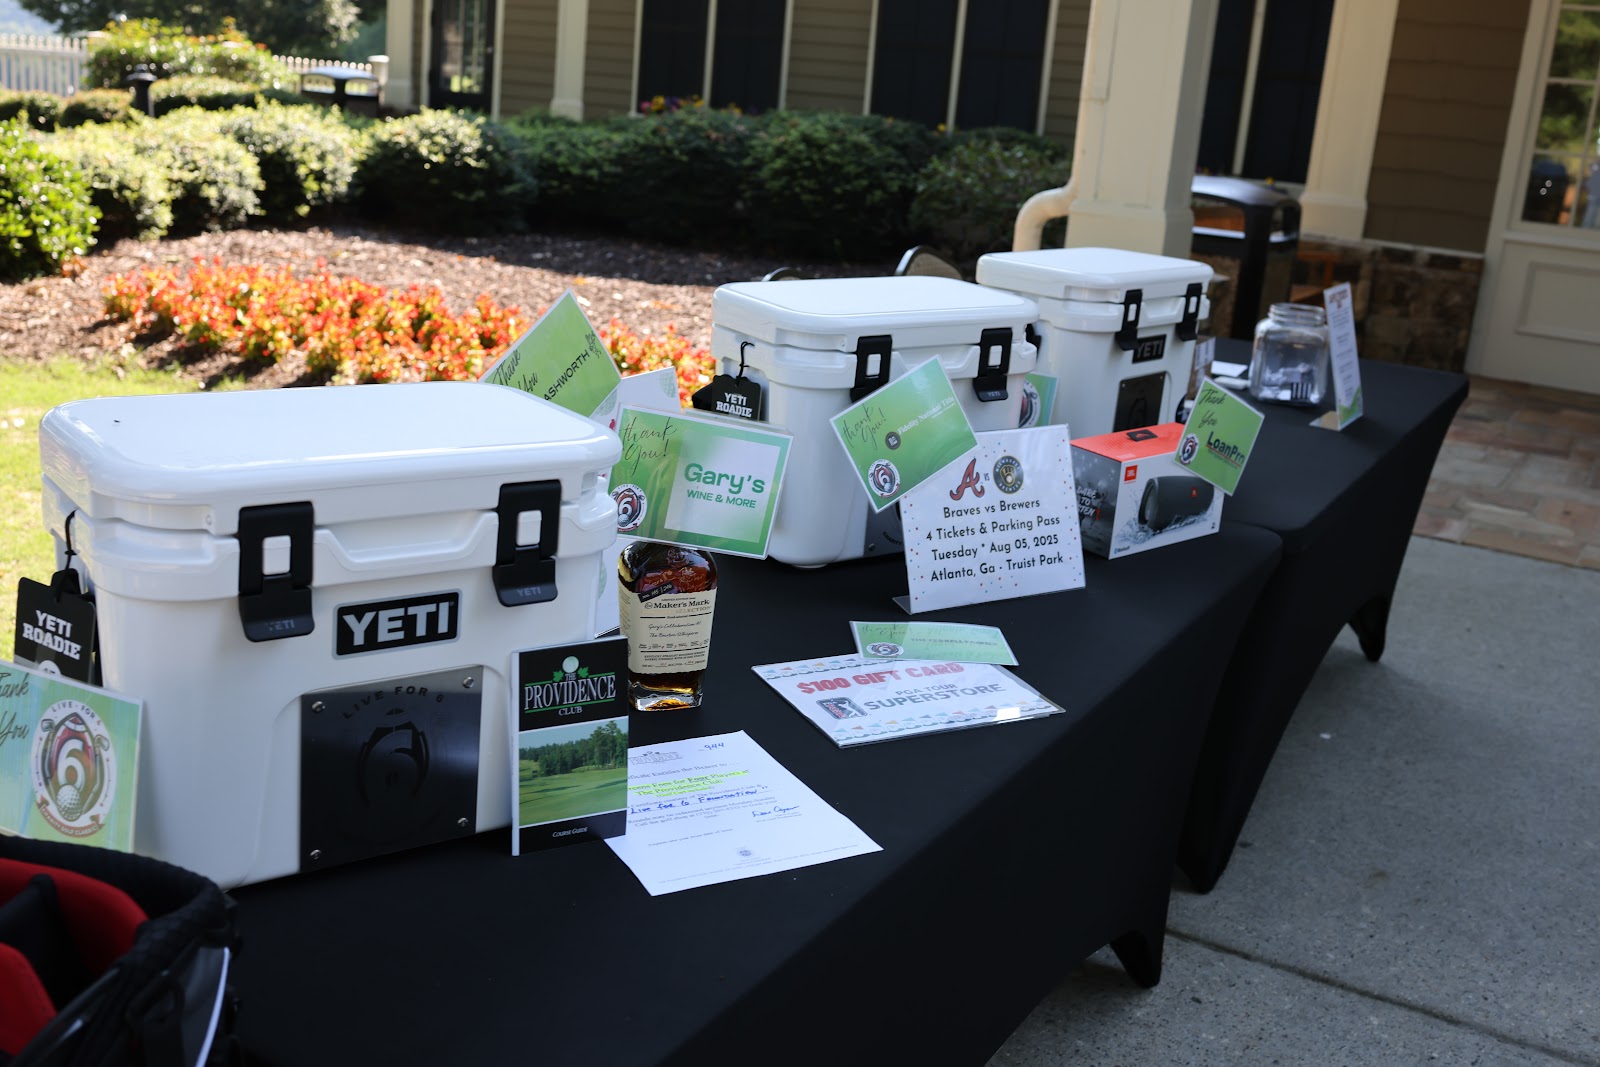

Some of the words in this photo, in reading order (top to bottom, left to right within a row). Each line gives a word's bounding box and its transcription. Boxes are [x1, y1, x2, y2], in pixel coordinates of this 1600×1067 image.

[1137, 340, 1163, 358] YETI
[544, 350, 590, 400] ASHWORTH
[724, 392, 747, 406] YETI
[1199, 388, 1227, 405] Thank
[716, 402, 752, 417] ROADIE
[897, 418, 918, 434] Fidelity
[918, 403, 942, 422] National
[1207, 432, 1244, 464] LoanPro
[684, 463, 765, 494] Gary's
[687, 490, 714, 501] WINE
[726, 496, 756, 508] MORE
[1077, 486, 1097, 498] DARE
[1081, 496, 1090, 506] TO
[944, 506, 980, 518] Braves
[984, 504, 996, 512] vs
[1000, 500, 1040, 512] Brewers
[926, 531, 932, 540] 4
[936, 526, 976, 540] Tickets
[980, 522, 988, 534] &
[992, 518, 1033, 532] Parking
[1037, 516, 1060, 526] Pass
[932, 545, 978, 560] Tuesday
[990, 542, 1011, 554] Aug
[1015, 539, 1030, 550] 05,
[1034, 534, 1058, 547] 2025
[931, 568, 976, 582] Atlanta,
[980, 562, 995, 574] Ga
[1006, 558, 1036, 570] Truist
[1040, 552, 1063, 566] Park
[516, 587, 541, 597] YETI
[36, 610, 72, 638] YETI
[264, 620, 295, 631] YETI
[342, 602, 450, 646] YETI
[23, 622, 82, 660] ROADIE
[0, 672, 29, 698] ank
[565, 672, 576, 681] THE
[797, 678, 850, 694] $100
[852, 670, 902, 685] GIFT
[905, 662, 964, 678] CARD
[343, 690, 384, 718] LIVE
[394, 686, 428, 696] FOR
[524, 674, 617, 711] PROVIDENCE
[864, 684, 1006, 710] SUPERSTORE
[896, 688, 922, 696] PGA
[926, 684, 958, 692] TOUR
[52, 701, 73, 712] LIVE
[81, 706, 96, 719] FOR
[558, 706, 582, 716] CLUB
